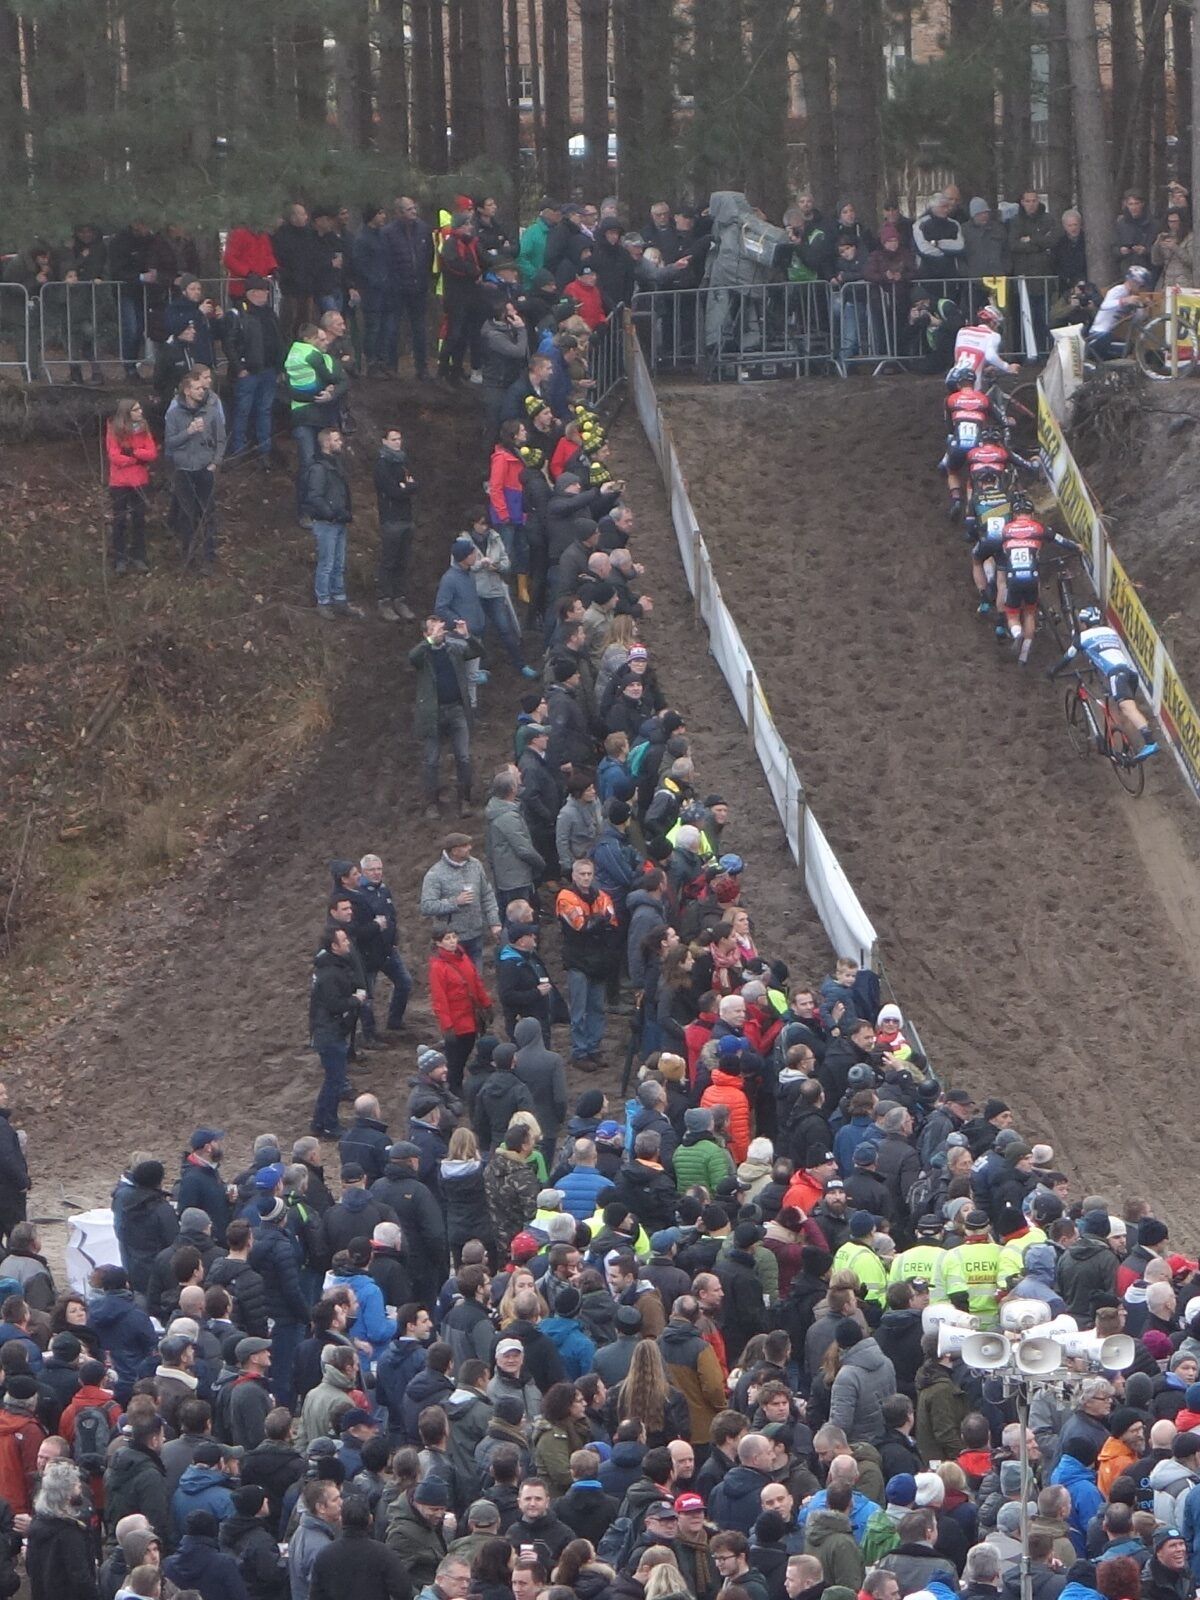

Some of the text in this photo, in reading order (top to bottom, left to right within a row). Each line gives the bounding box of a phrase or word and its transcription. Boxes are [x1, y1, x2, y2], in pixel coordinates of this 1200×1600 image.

[993, 520, 1000, 530] 5
[1013, 551, 1028, 561] 46
[903, 1262, 933, 1273] CREW
[965, 1260, 999, 1272] CREW
